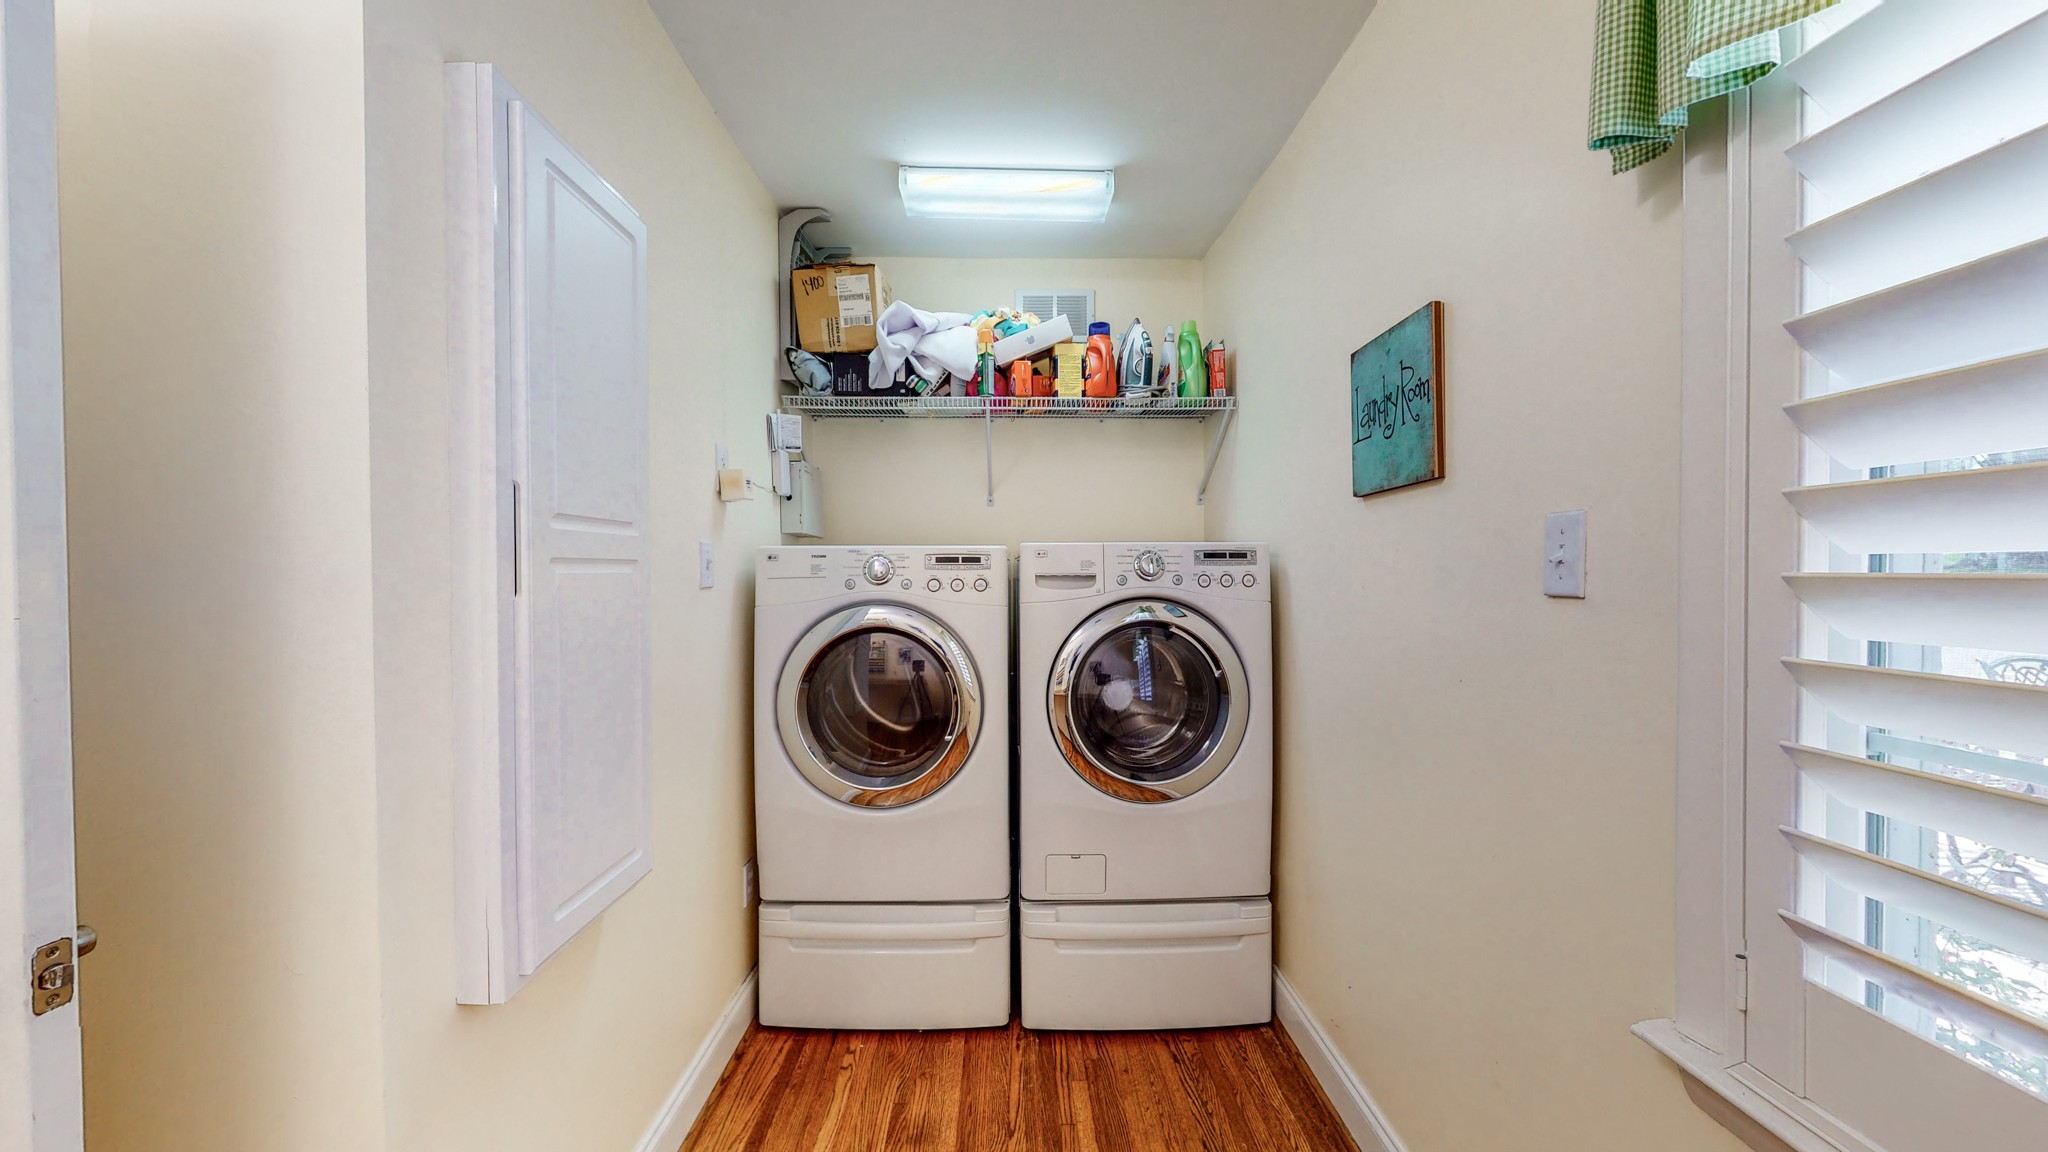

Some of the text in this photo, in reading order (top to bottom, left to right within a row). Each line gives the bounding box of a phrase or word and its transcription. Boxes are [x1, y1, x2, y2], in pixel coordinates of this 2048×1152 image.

[801, 275, 825, 297] 1400
[1353, 359, 1432, 446] Laundry Room
